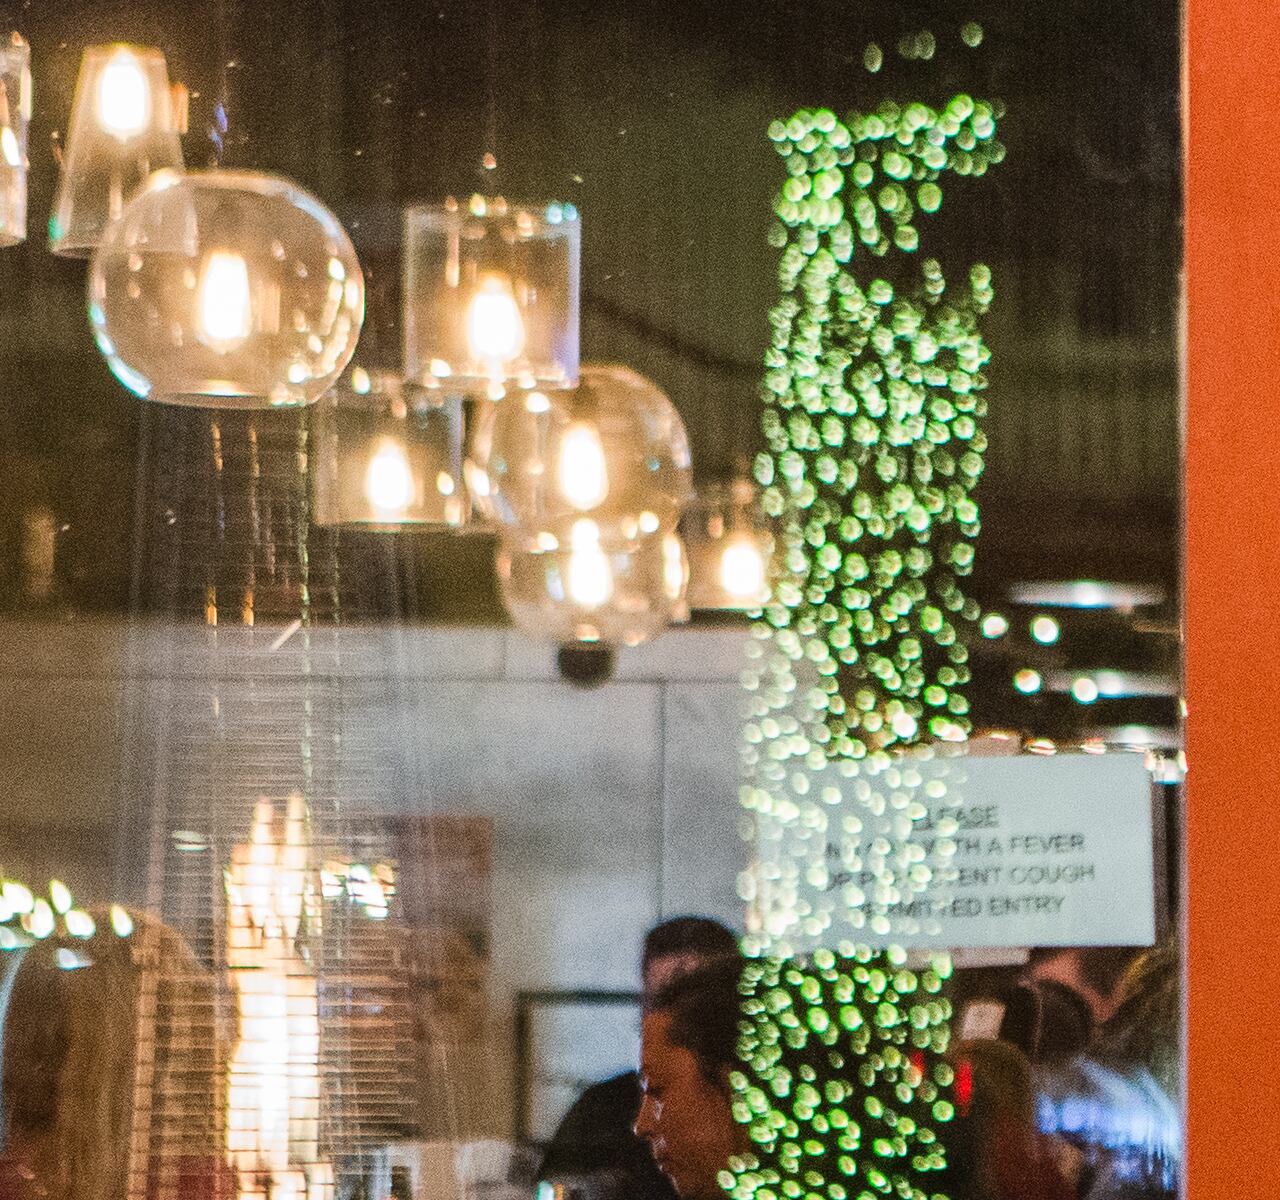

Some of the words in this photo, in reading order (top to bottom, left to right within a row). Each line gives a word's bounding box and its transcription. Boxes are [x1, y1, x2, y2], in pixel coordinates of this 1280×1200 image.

[988, 838, 1001, 855] A
[1009, 832, 1084, 854] FEVER
[1008, 863, 1096, 884] COUGH
[988, 895, 1066, 917] ENTRY
